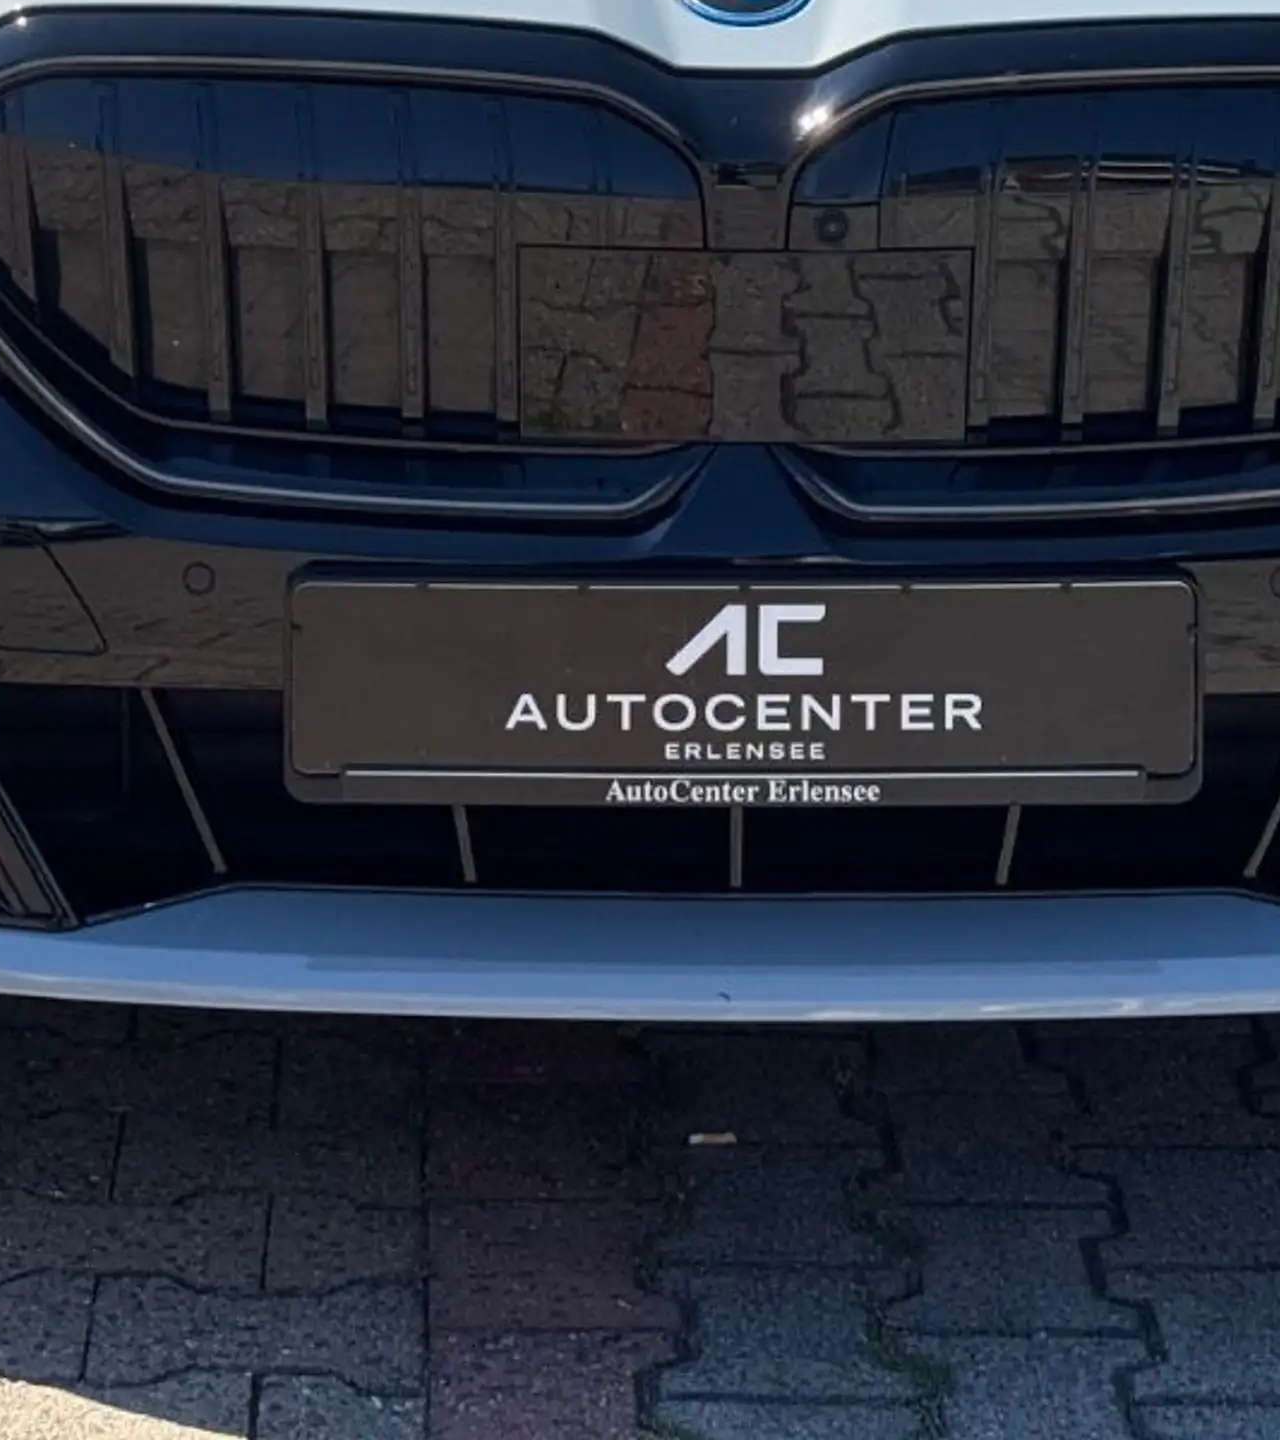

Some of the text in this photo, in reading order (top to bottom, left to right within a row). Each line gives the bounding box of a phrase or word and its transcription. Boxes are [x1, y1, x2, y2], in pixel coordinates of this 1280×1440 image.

[506, 694, 982, 732] AUTOCENTER
[665, 742, 825, 760] ERLENSEE
[606, 779, 880, 803] AutoCenter Erlensee
